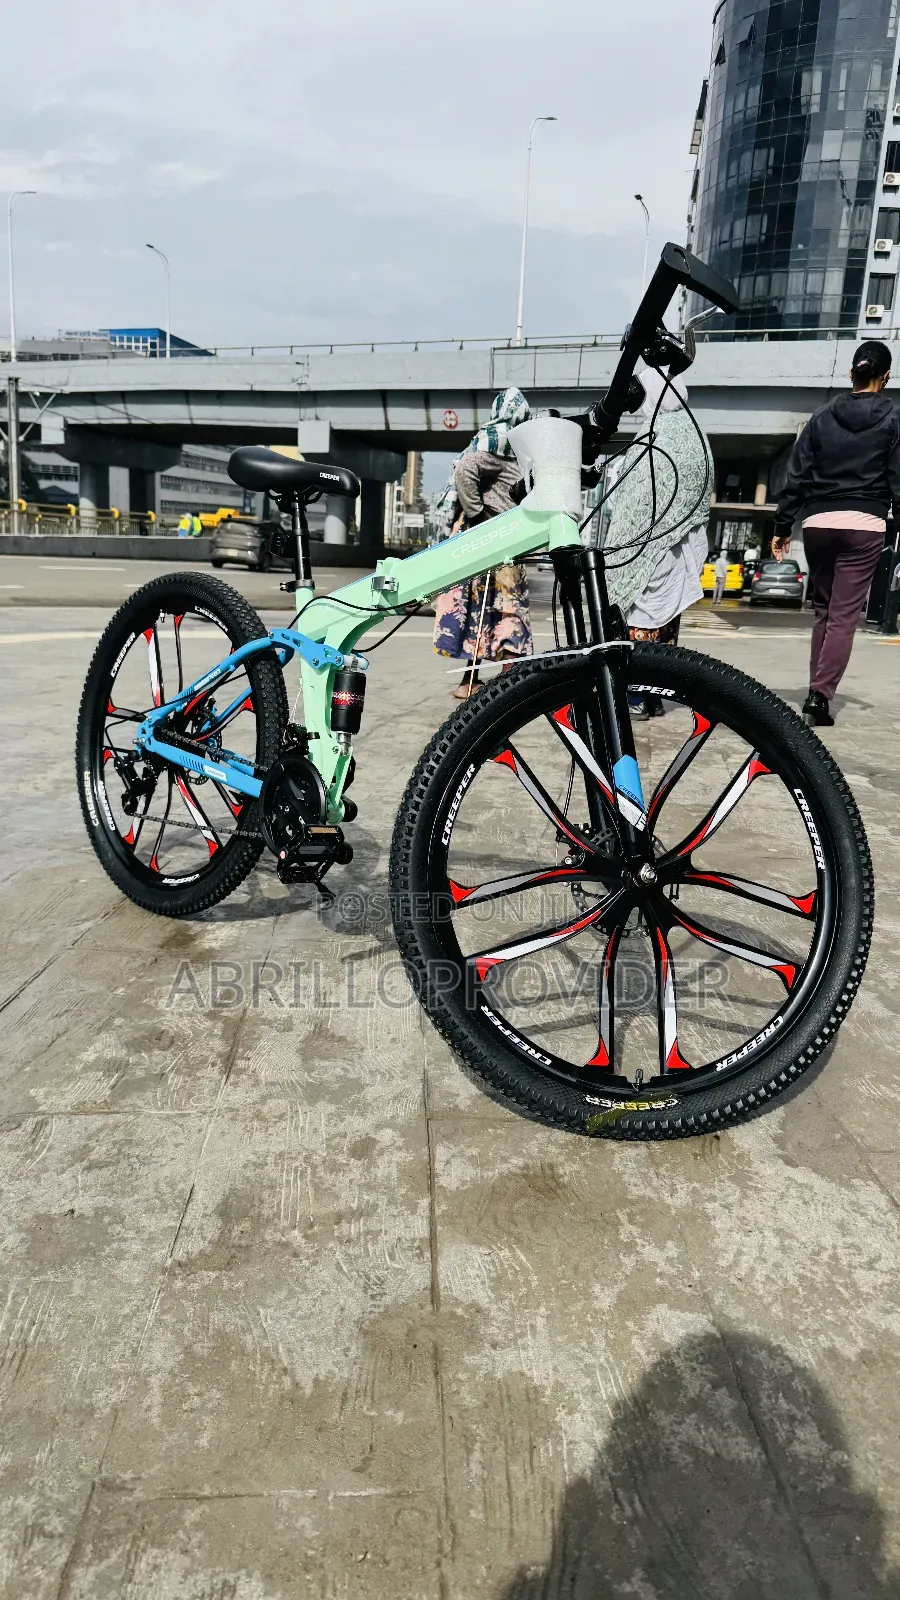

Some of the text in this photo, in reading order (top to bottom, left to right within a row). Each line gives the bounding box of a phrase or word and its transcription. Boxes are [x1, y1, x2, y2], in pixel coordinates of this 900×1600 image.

[452, 520, 520, 559] CREEPER
[110, 631, 136, 678] CREEPER
[627, 683, 676, 697] EPER
[84, 770, 100, 827] CREEPER
[441, 763, 476, 846] CREEPER
[793, 788, 826, 871] CREEPER
[480, 1005, 553, 1066] CREEPER
[715, 1015, 784, 1072] CREEPER
[583, 1094, 681, 1111] CREEPER
